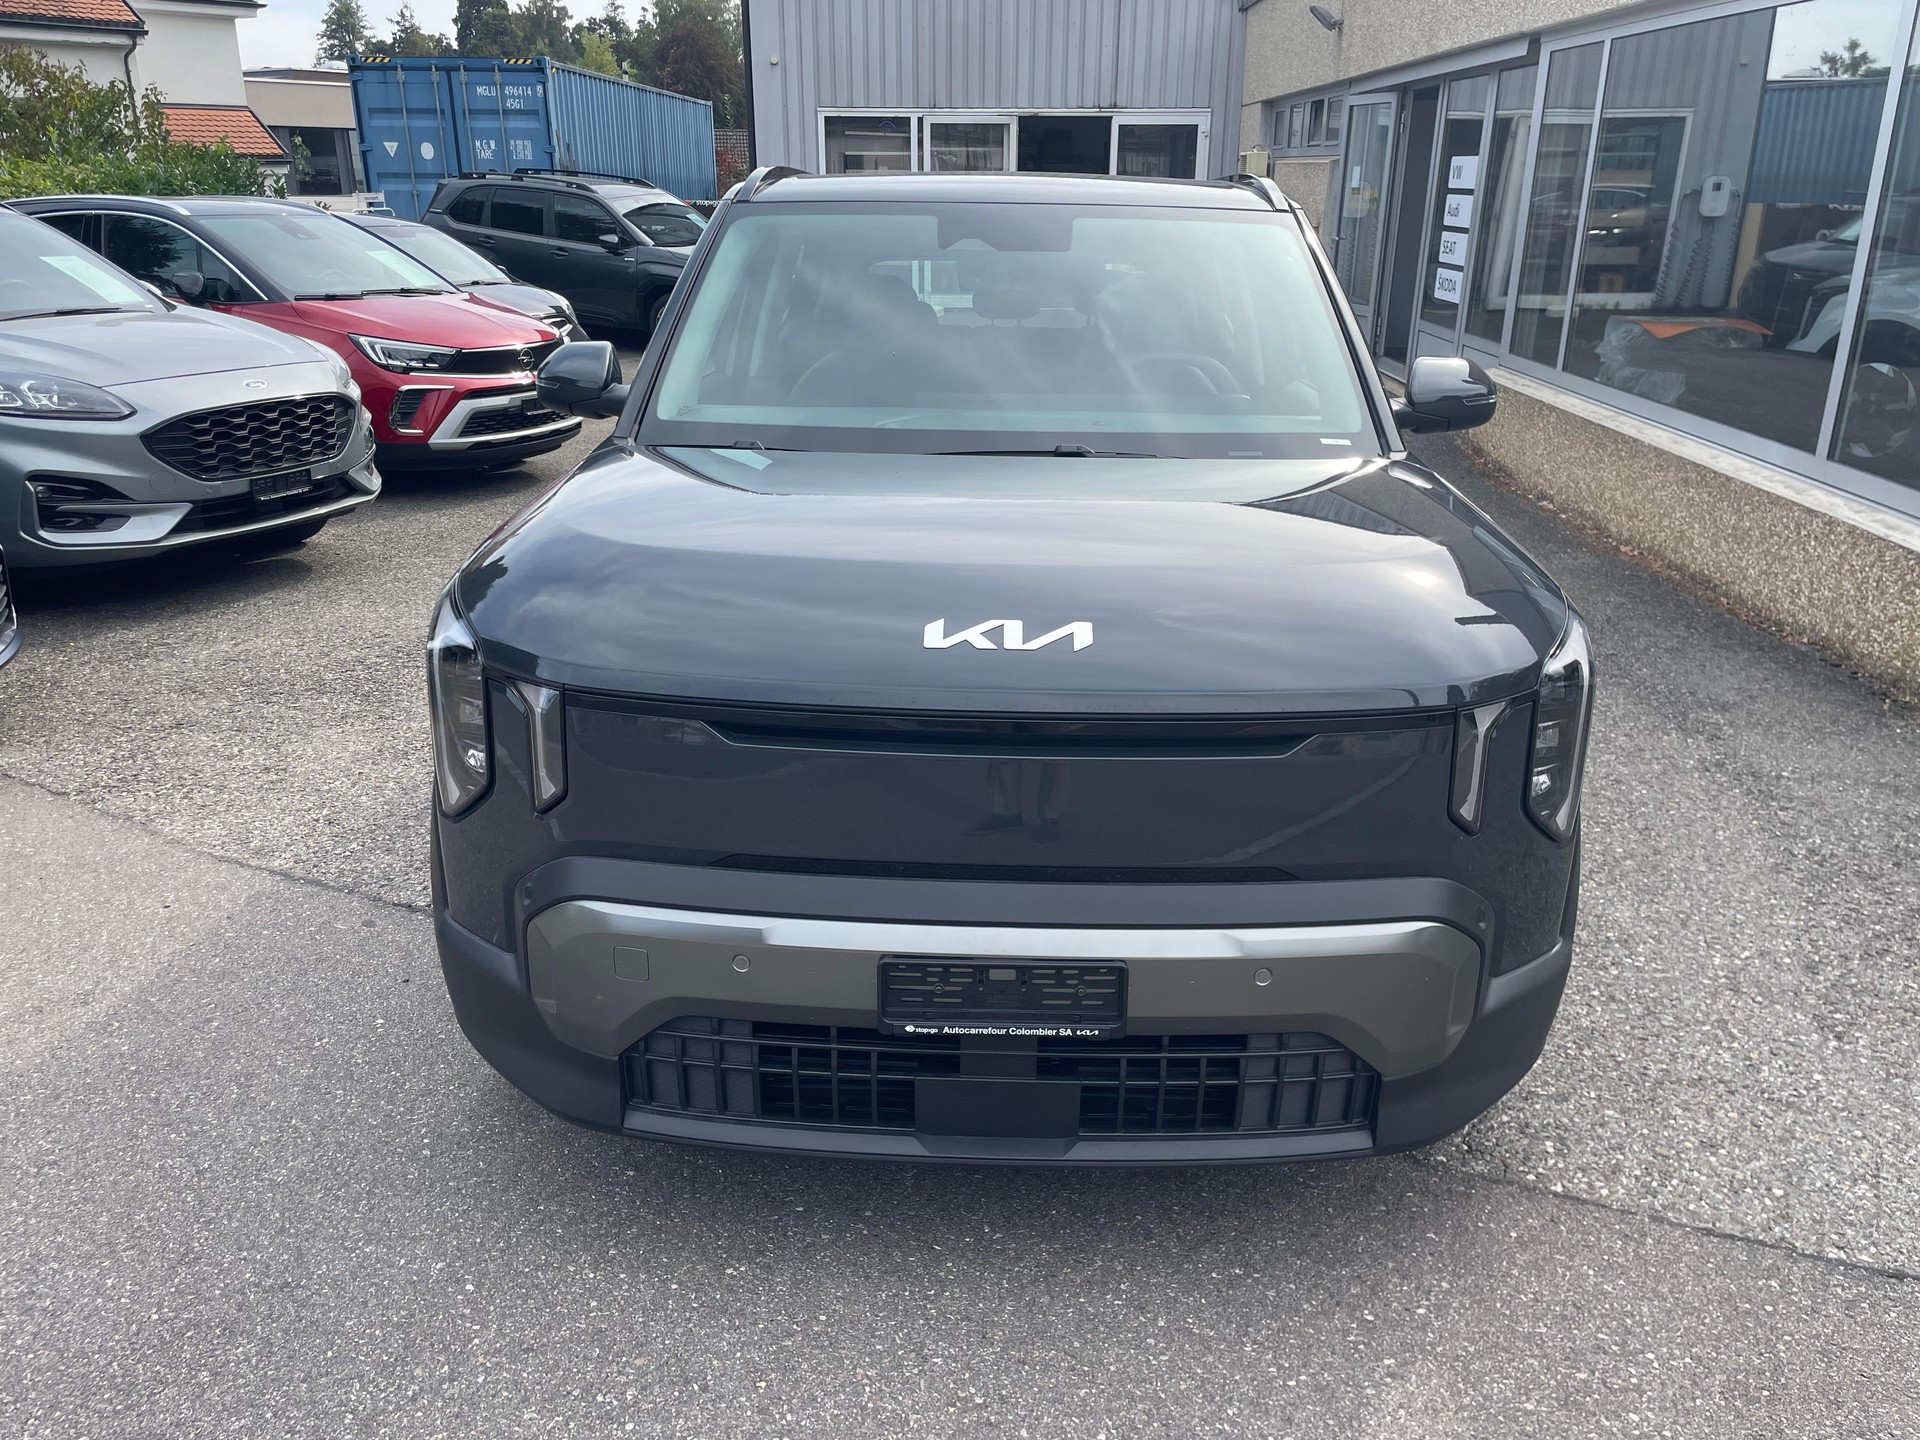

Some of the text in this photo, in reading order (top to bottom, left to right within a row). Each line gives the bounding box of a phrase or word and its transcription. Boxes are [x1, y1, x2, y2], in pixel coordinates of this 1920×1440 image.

[476, 86, 496, 96] MGLU
[504, 86, 532, 96] 496414
[506, 99, 524, 109] 45G1
[477, 150, 494, 159] TARE
[1452, 165, 1463, 180] VW
[1447, 203, 1460, 217] Audi
[1442, 240, 1456, 255] SEAT
[923, 618, 1094, 652] KIA
[942, 1026, 1007, 1035] Autocarrefour
[1009, 1027, 1057, 1036] Colombier
[1059, 1028, 1073, 1036] SA
